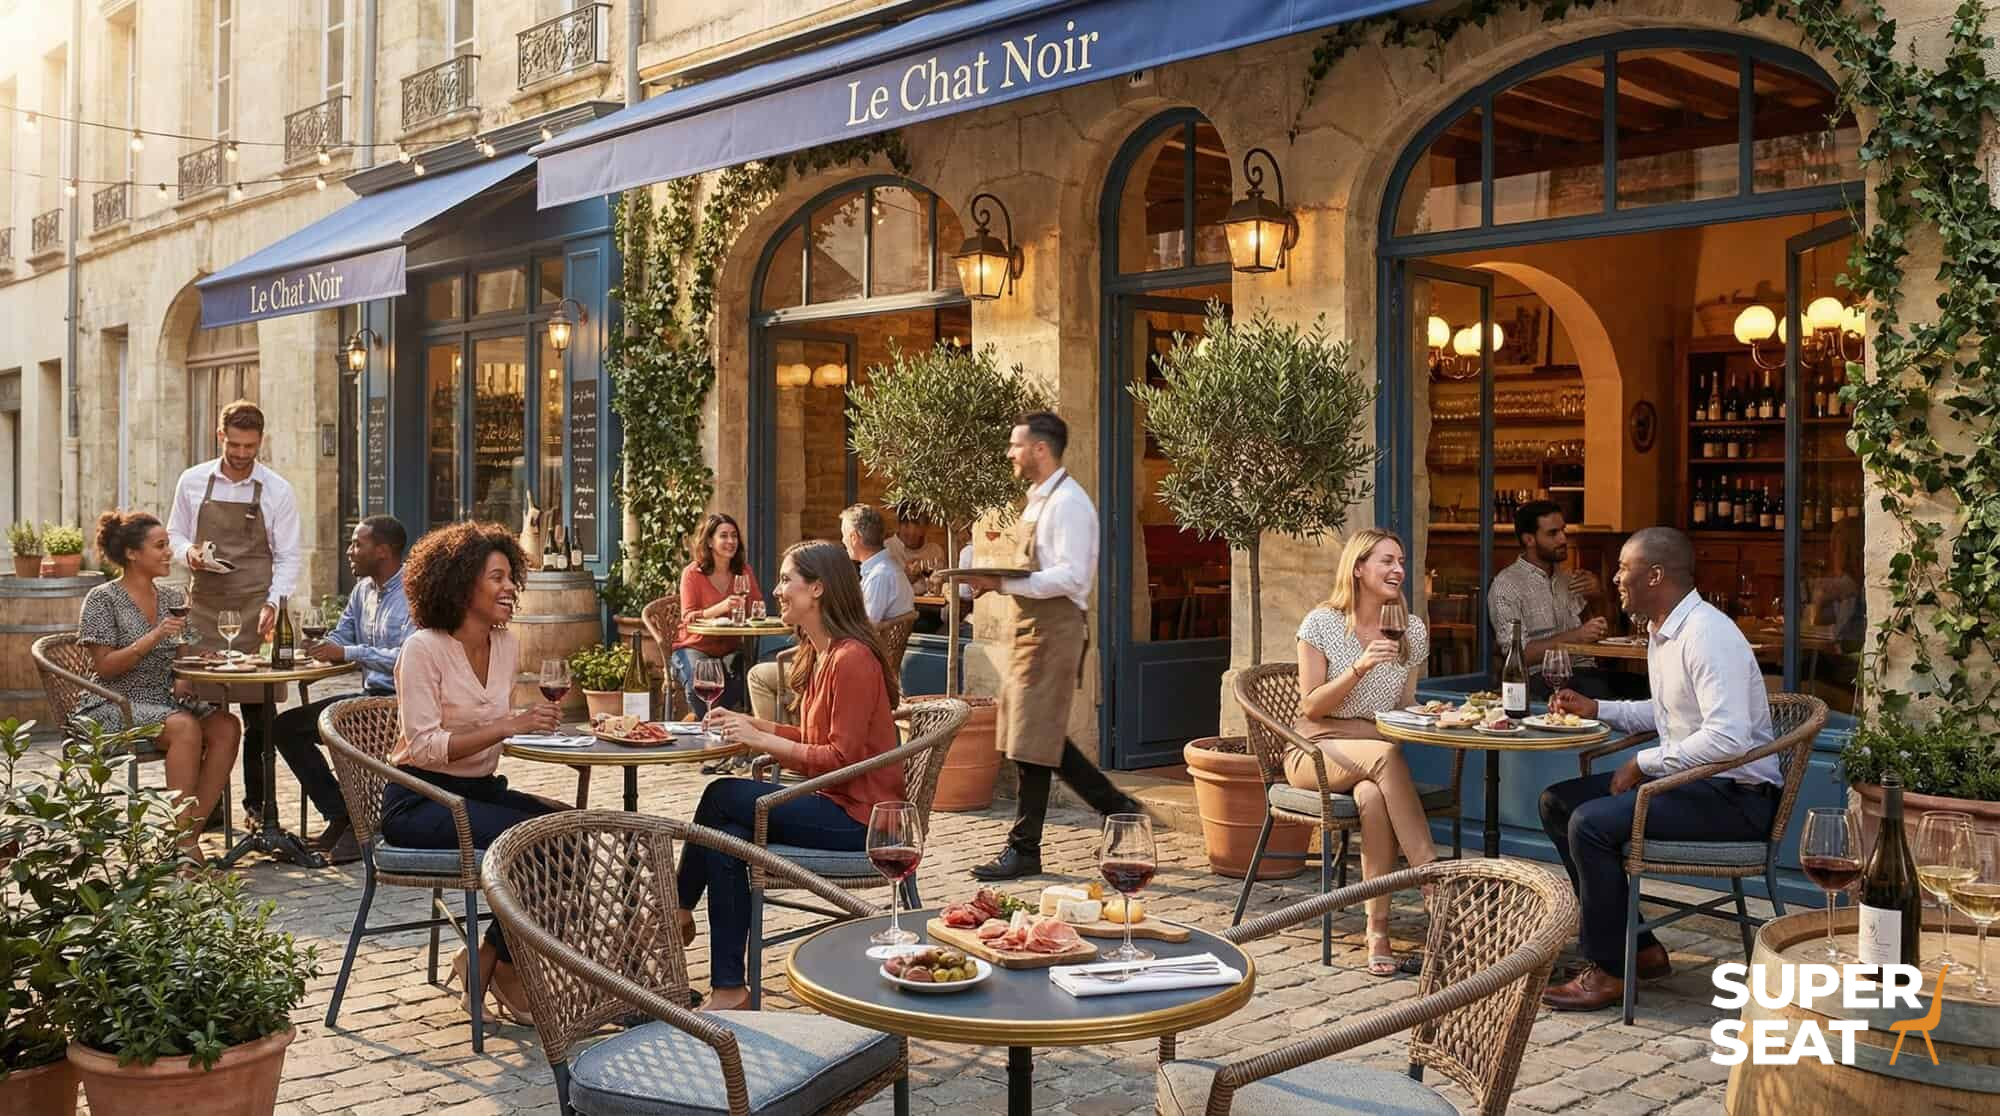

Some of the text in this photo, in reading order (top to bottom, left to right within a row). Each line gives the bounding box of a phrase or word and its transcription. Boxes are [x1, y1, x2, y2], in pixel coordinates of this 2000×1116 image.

[846, 20, 1098, 126] Le Chat Noir
[249, 266, 343, 313] Le Chat Noir
